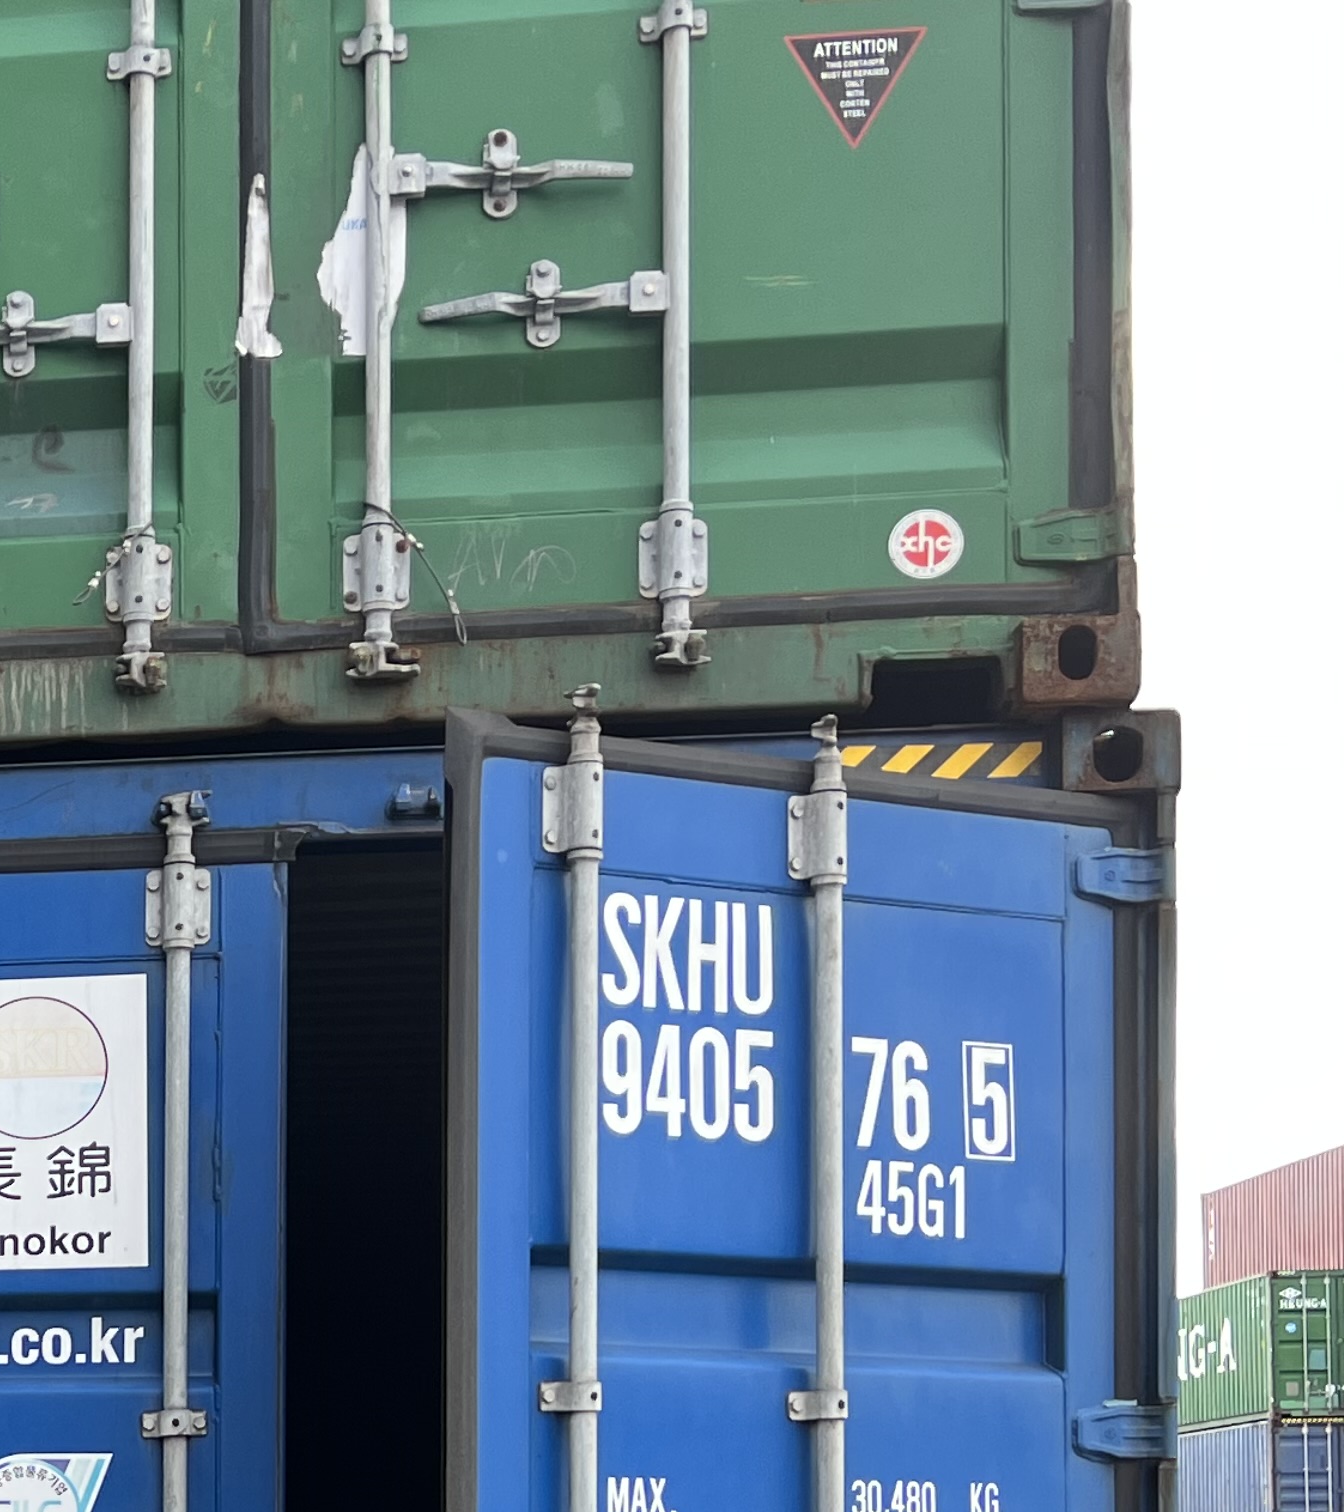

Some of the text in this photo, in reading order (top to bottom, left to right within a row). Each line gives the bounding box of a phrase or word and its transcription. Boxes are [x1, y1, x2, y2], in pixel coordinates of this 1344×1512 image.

[813, 38, 898, 58] ATTENTION
[601, 892, 775, 1016] SKHU
[601, 1019, 1010, 1157] 9405 76 5
[857, 1160, 966, 1240] 45G1
